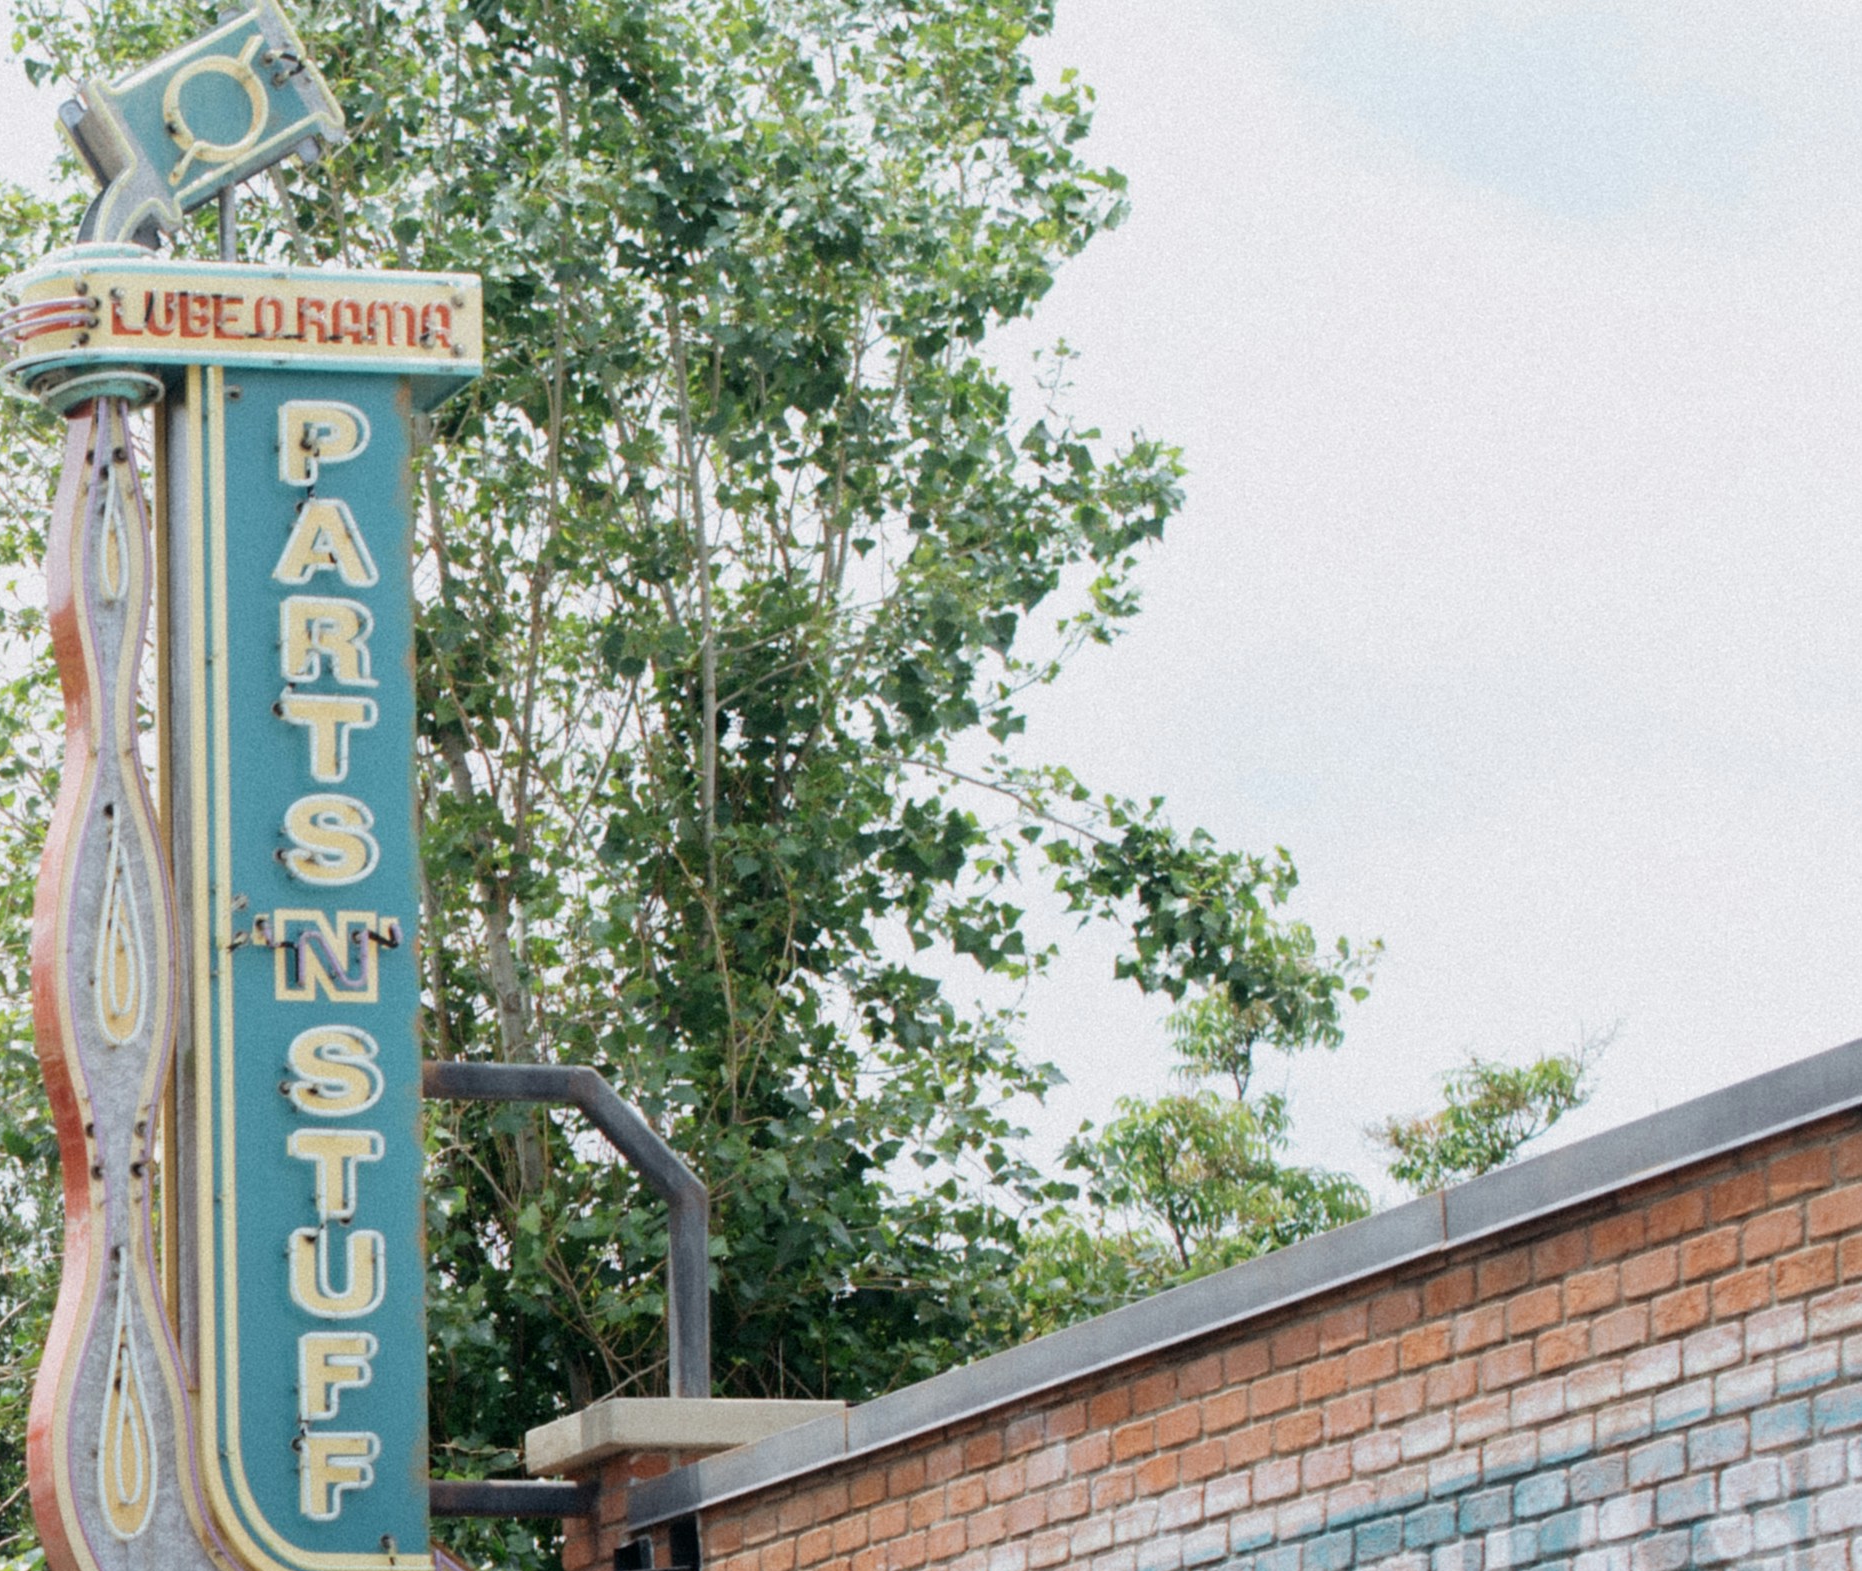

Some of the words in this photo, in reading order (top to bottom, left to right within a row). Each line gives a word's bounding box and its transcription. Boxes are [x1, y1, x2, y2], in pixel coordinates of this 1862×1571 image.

[111, 289, 245, 340] LUBE
[272, 400, 379, 885] PARTS
[284, 1024, 388, 1522] STUFF
